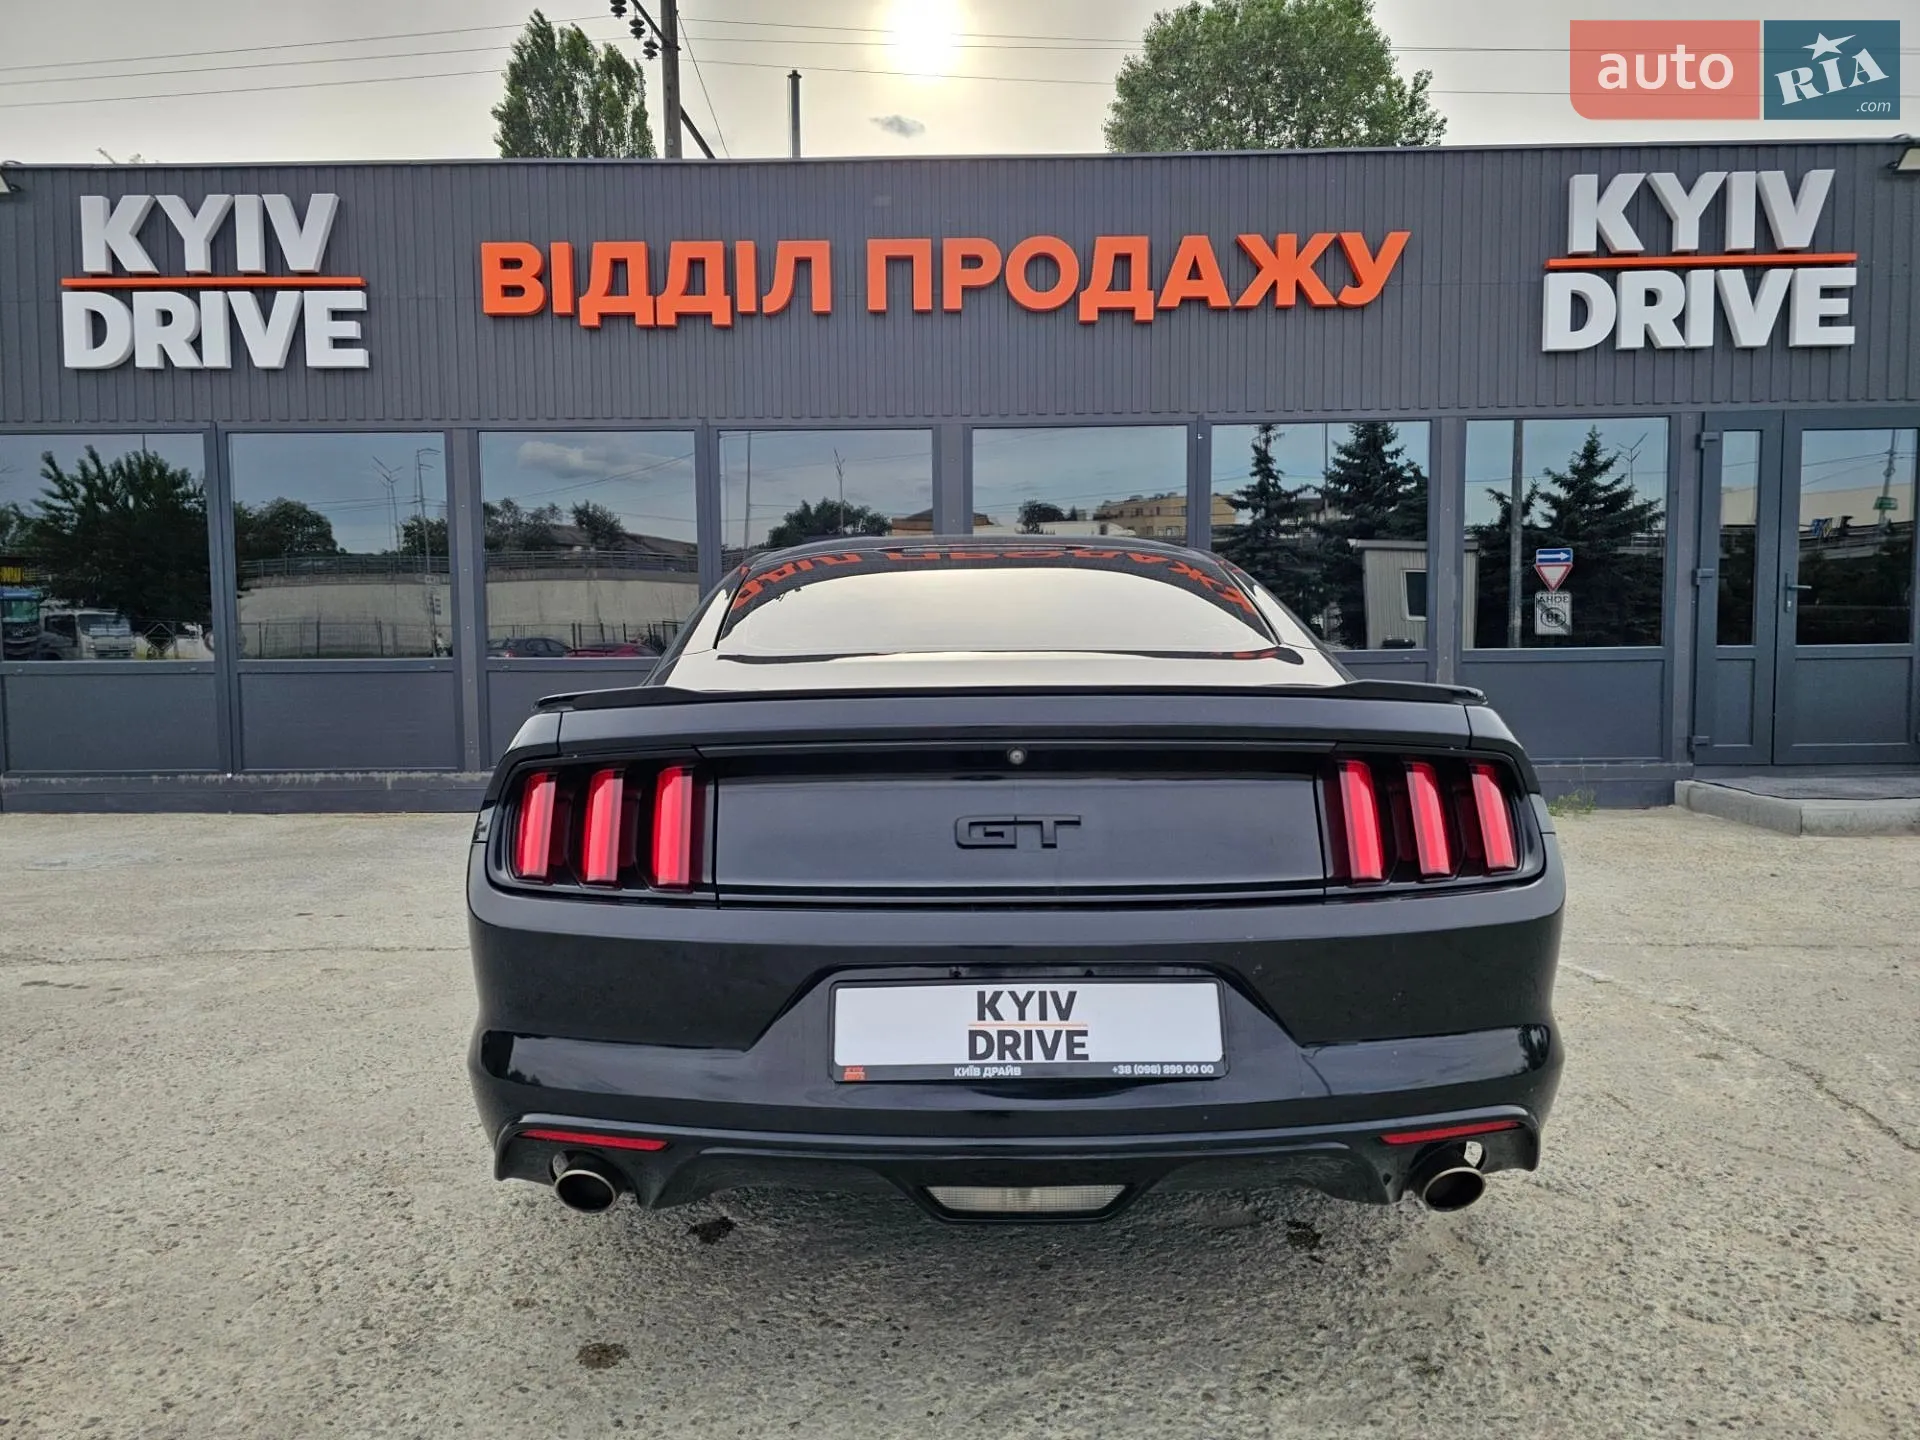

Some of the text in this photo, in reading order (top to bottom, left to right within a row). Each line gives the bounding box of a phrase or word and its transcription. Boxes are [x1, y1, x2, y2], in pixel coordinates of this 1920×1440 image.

[80, 193, 339, 275] KYIV
[1568, 169, 1836, 256] KYIV
[481, 231, 1411, 328] ВІДДІЛ ПРОДАЖУ
[61, 290, 370, 370] DRIVE
[1542, 267, 1858, 353] DRIVE
[955, 815, 1081, 849] GT
[976, 990, 1077, 1022] KYIV
[954, 1065, 1022, 1077] КИЇВ ДРАЙВ
[968, 1029, 1089, 1061] DRIVE
[1112, 1064, 1132, 1075] +38
[1185, 1064, 1199, 1075] 00
[1200, 1064, 1214, 1075] 00
